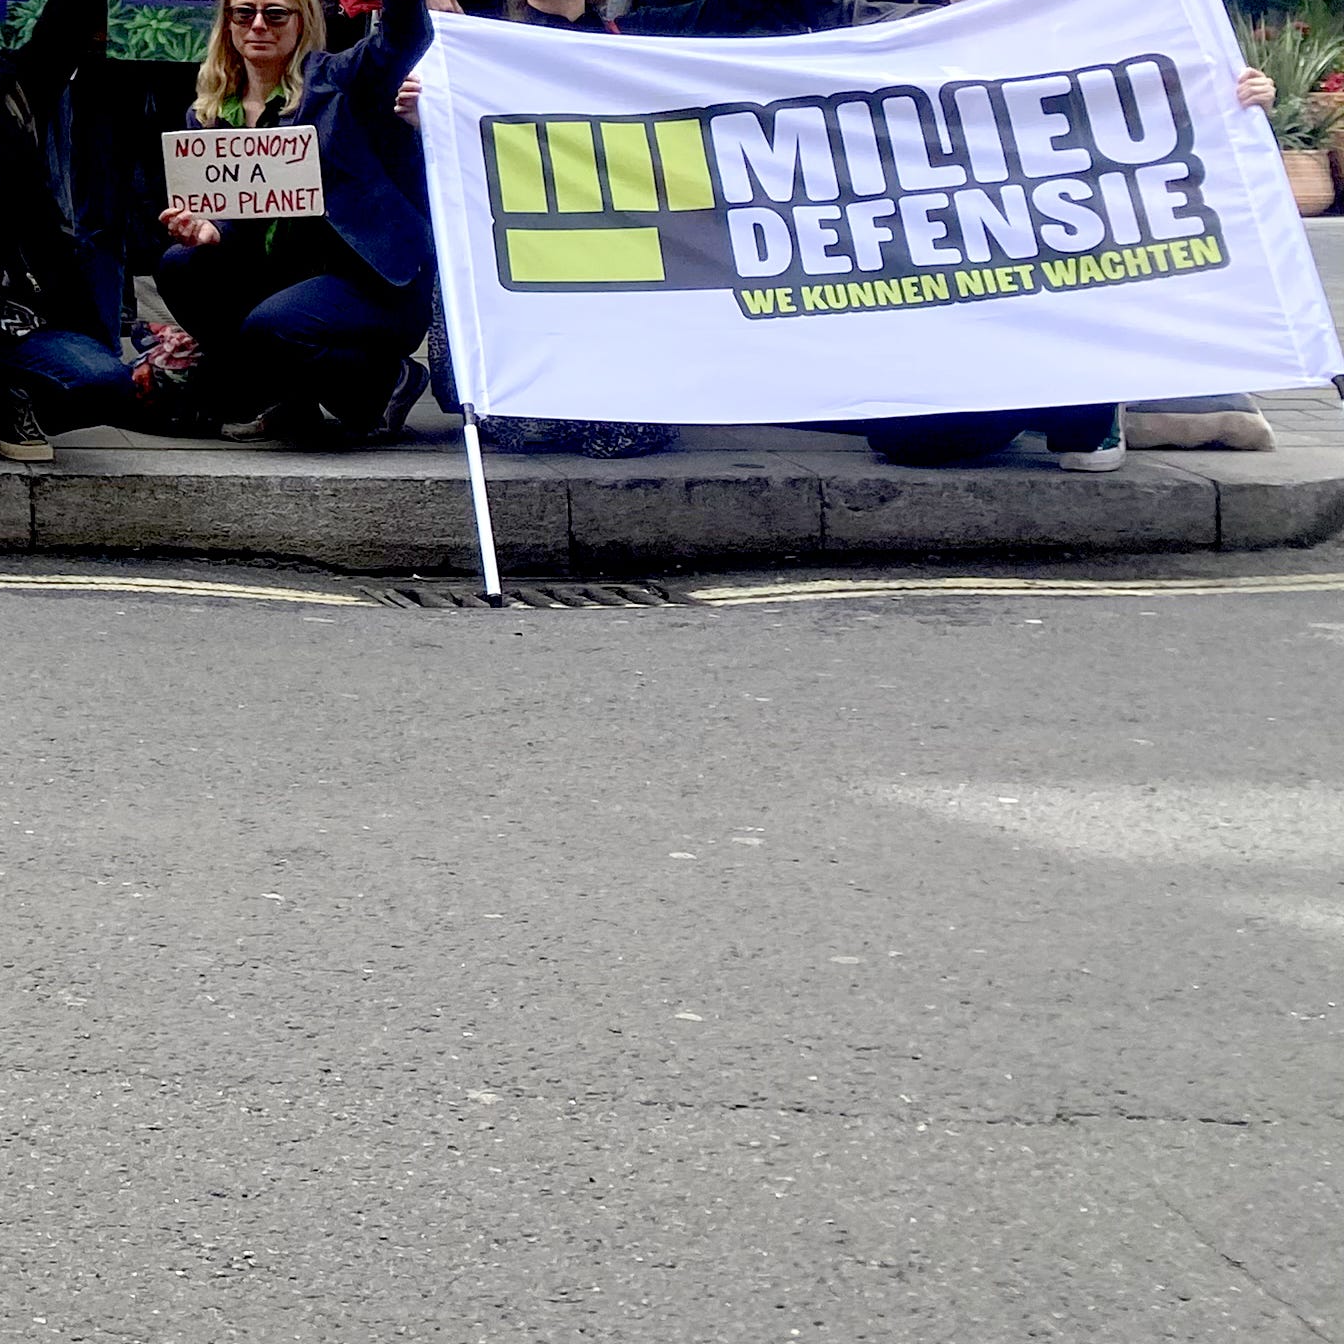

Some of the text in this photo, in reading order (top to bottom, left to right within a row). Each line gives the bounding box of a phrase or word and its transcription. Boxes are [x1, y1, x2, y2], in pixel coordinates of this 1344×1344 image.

[175, 134, 312, 165] NO ECONOMY
[709, 58, 1184, 203] MILIEU
[172, 187, 320, 214] DEAD PLANET
[205, 163, 267, 183] ON A
[726, 162, 1207, 279] DEFENSIE
[743, 235, 1223, 318] WE KUNNEN NIET WACHTEN
